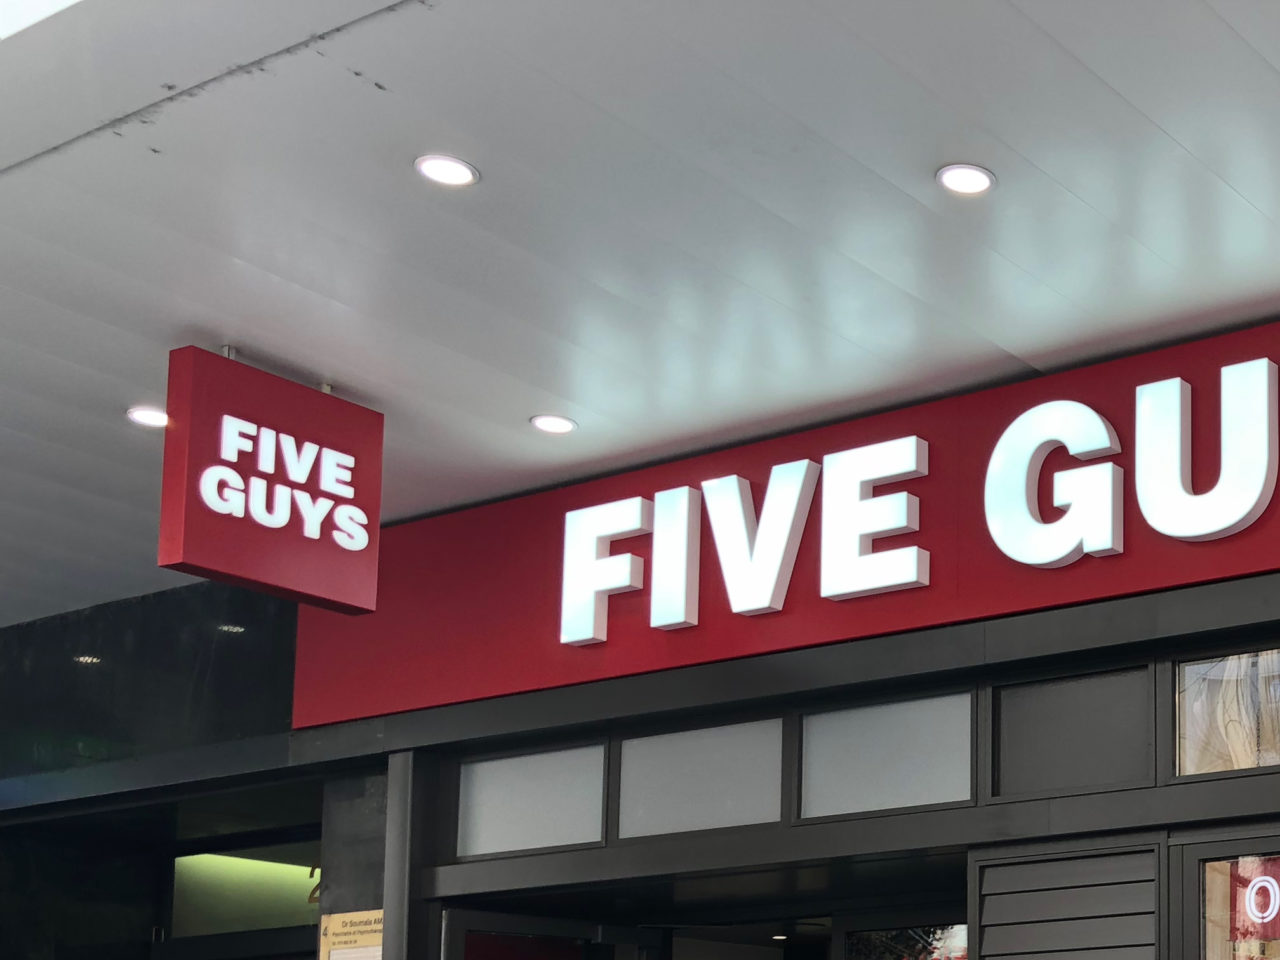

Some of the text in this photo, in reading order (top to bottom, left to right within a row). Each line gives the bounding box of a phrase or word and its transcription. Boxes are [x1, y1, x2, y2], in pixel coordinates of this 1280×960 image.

[219, 413, 356, 499] FIVE
[199, 465, 370, 552] GUYS
[559, 434, 931, 646] FIVE
